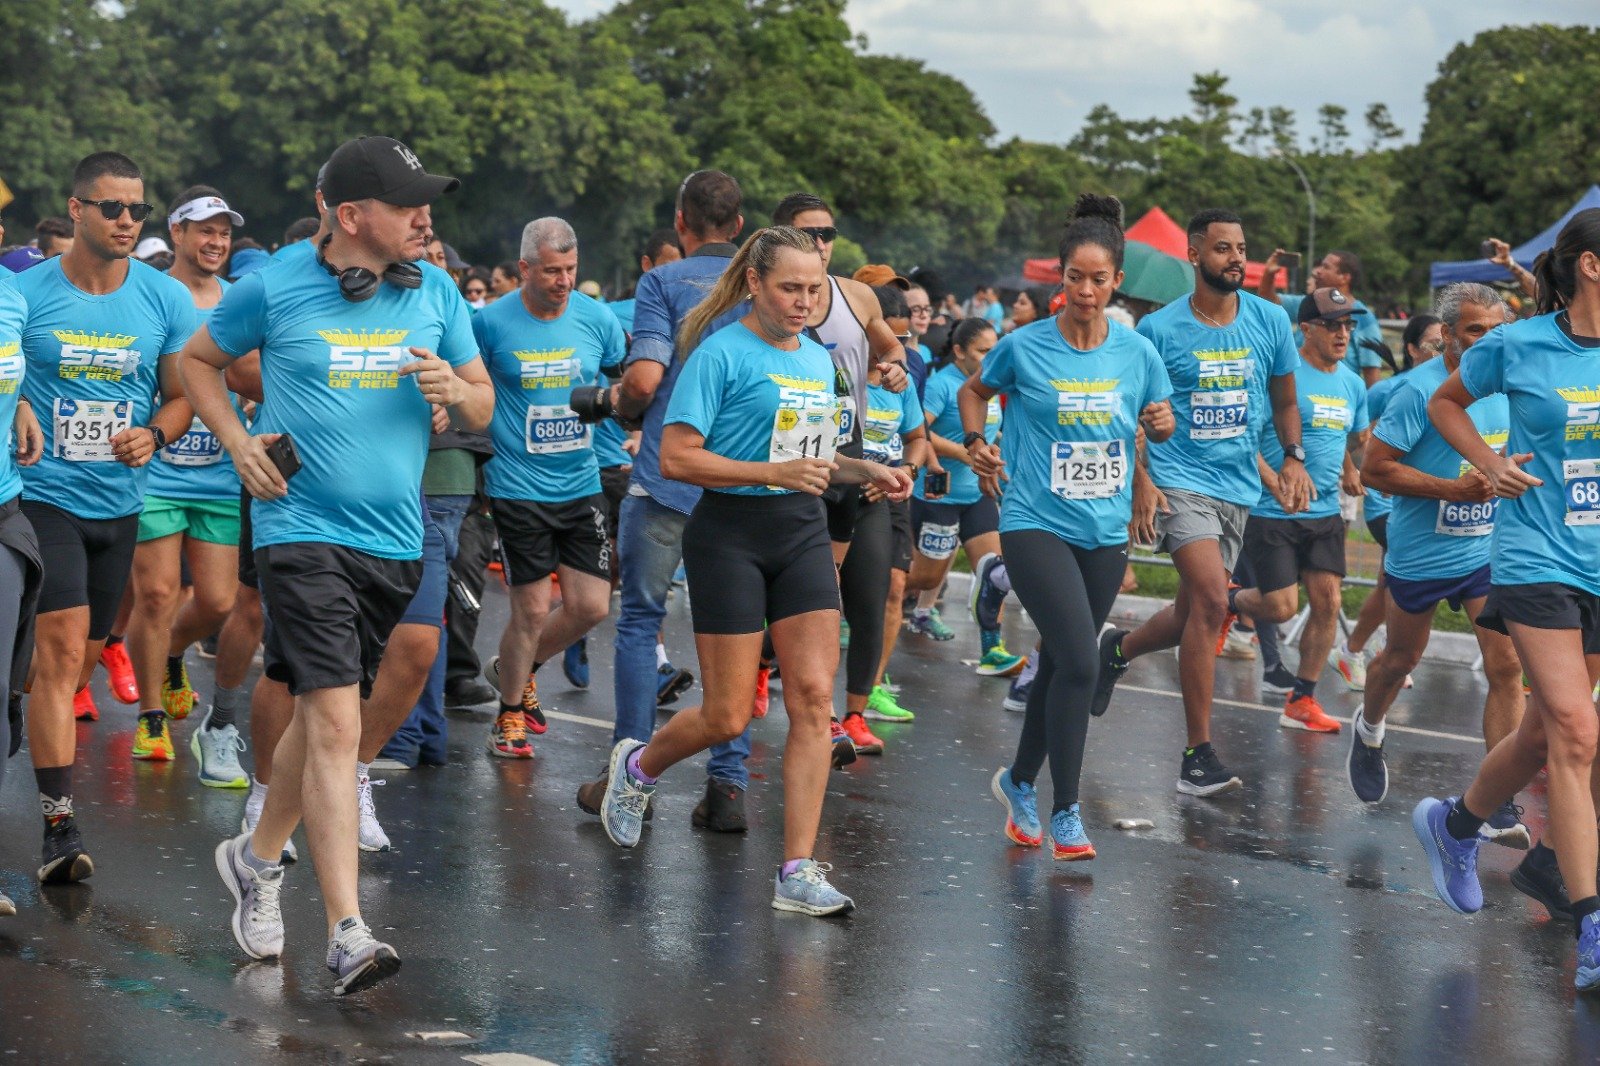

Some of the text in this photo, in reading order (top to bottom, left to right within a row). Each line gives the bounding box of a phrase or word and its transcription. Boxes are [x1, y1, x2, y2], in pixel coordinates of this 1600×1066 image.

[393, 145, 423, 170] LA
[60, 344, 127, 370] 52
[329, 346, 401, 370] 52
[59, 365, 122, 376] CORRIDA
[59, 371, 122, 382] DE REIS
[328, 371, 398, 380] CORRIDA
[521, 359, 570, 377] 52
[1199, 360, 1246, 377] 52
[328, 380, 398, 388] DE REIS
[779, 387, 831, 409] 52
[1057, 392, 1113, 411] 52
[1193, 407, 1246, 425] 60837
[1313, 404, 1347, 420] 52
[535, 420, 584, 438] 68026
[799, 434, 822, 458] 11
[1059, 461, 1121, 480] 12515
